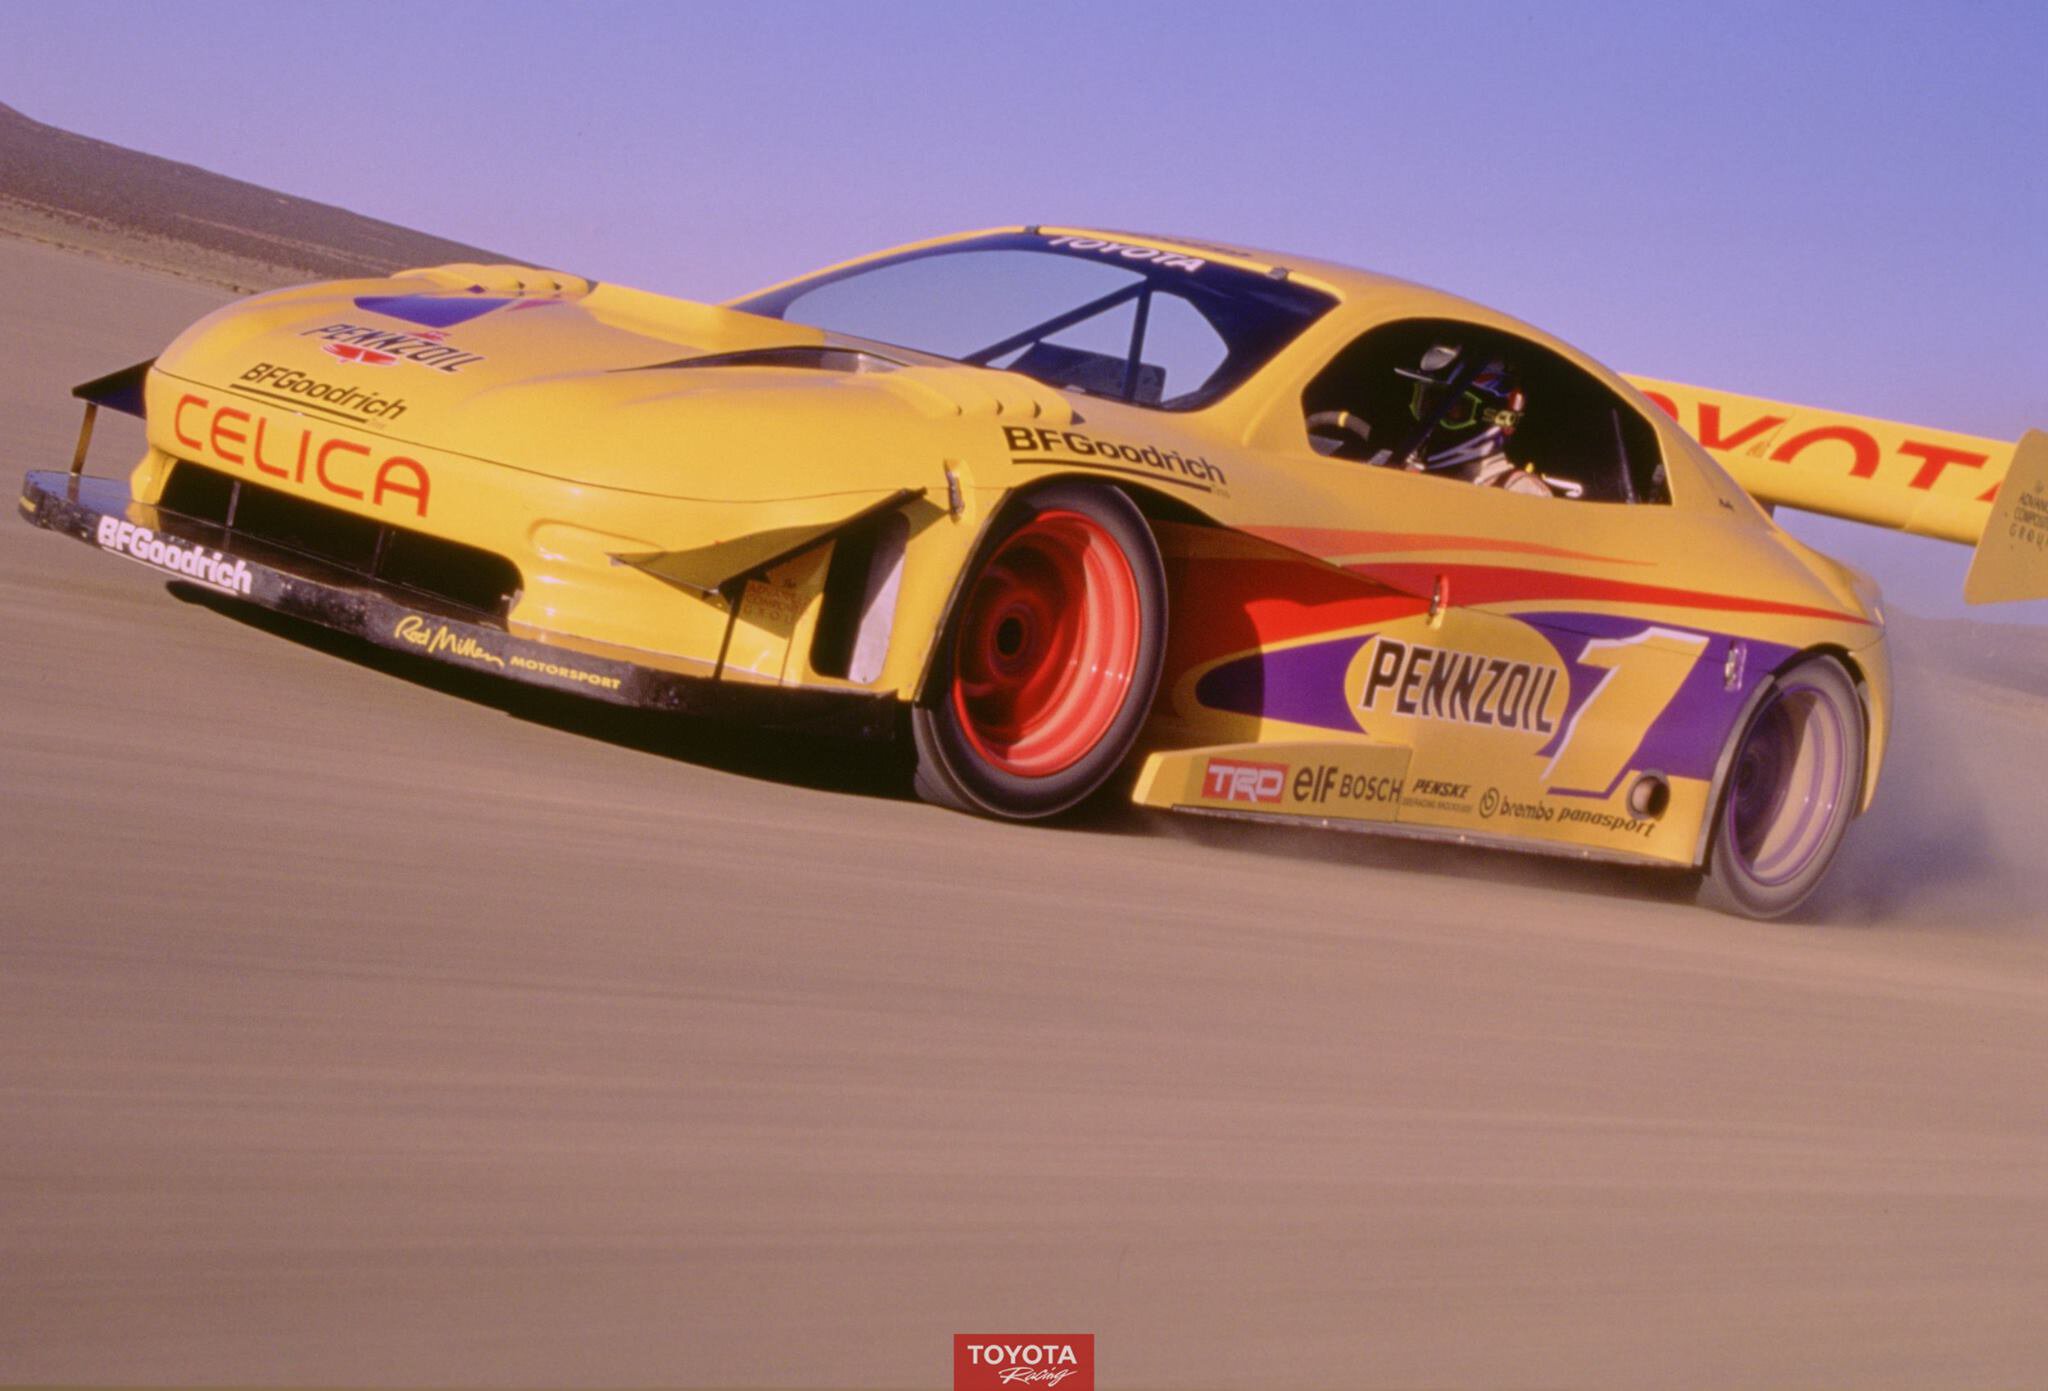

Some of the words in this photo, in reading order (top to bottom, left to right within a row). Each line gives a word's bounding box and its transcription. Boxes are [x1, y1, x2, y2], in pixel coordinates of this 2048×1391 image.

[1049, 236, 1205, 272] TOYOTA
[300, 323, 486, 374] PENNZOIL
[240, 362, 408, 420] BFGoodrich
[174, 393, 431, 518] CELICA
[1001, 426, 1226, 485] BFGoodrich
[98, 515, 252, 594] BFGoodrich
[509, 655, 622, 690] MOTORSPORT
[1359, 636, 1559, 736] PENNZOIL
[1540, 625, 1711, 800] 1
[1208, 764, 1284, 803] TRD
[1292, 765, 1339, 804] elf
[1339, 774, 1404, 804] BOSCH
[1412, 779, 1472, 799] PENSKE
[1500, 797, 1554, 821] brembo
[1557, 807, 1656, 838] panasport
